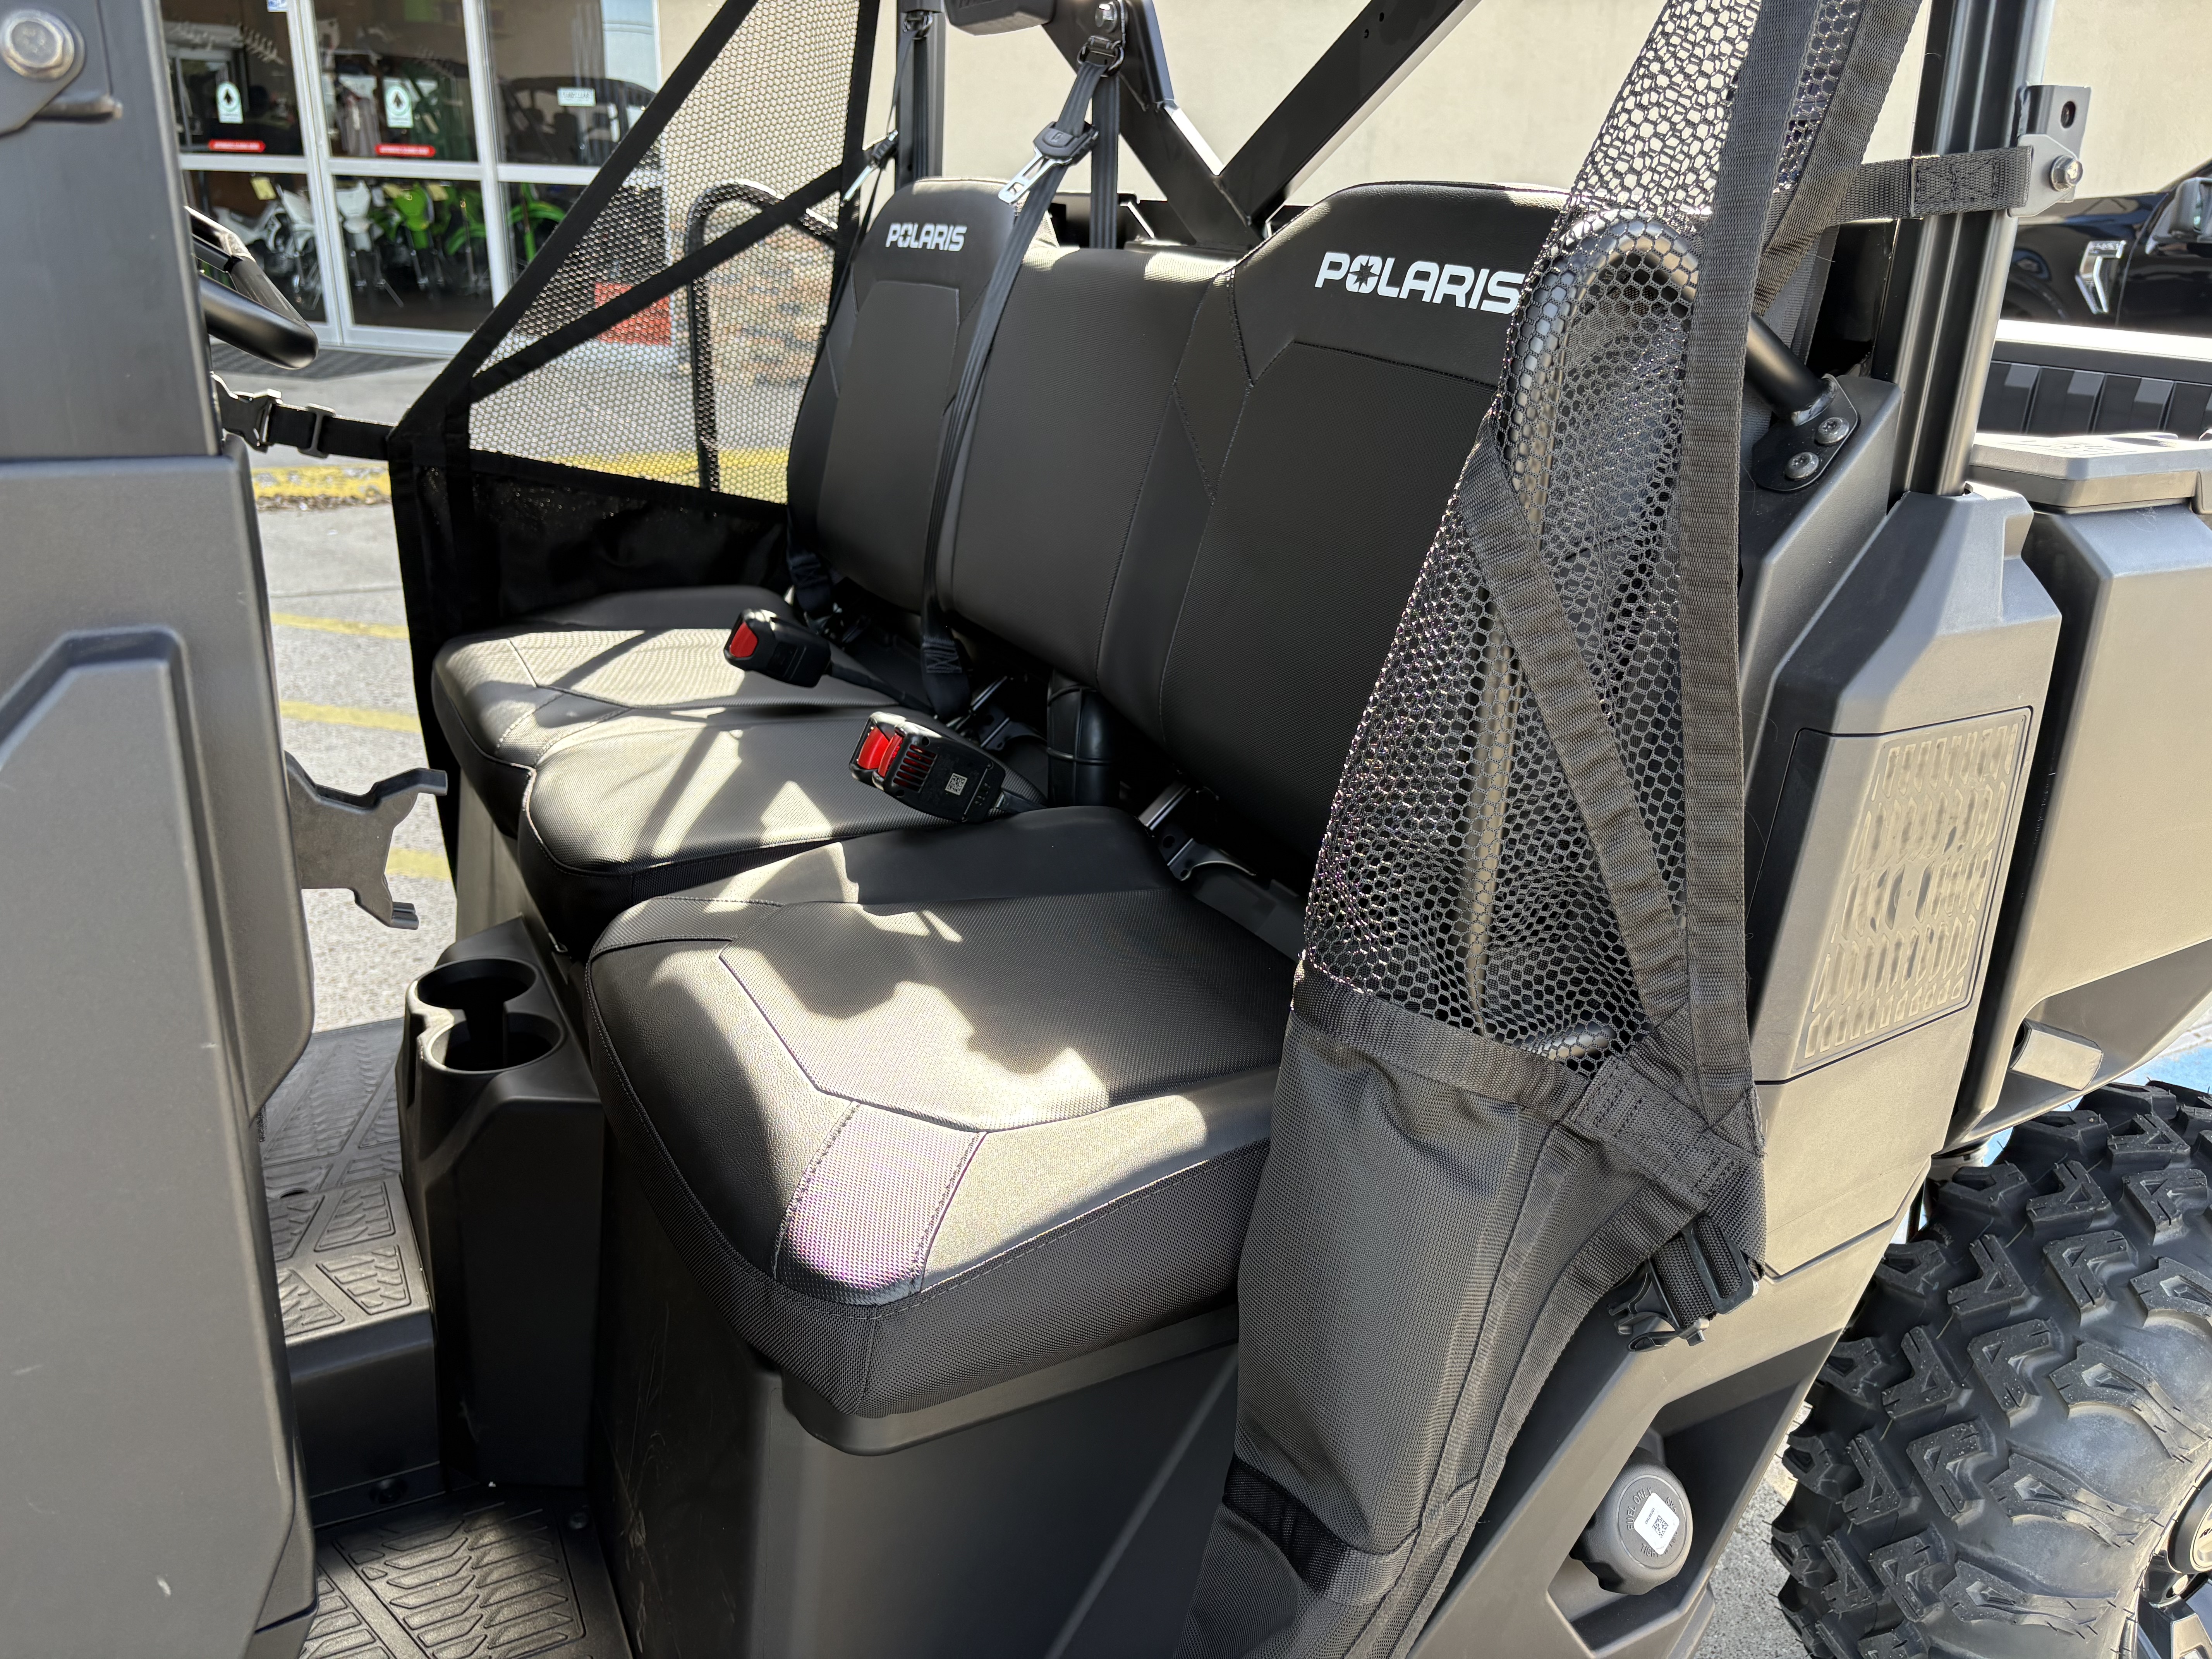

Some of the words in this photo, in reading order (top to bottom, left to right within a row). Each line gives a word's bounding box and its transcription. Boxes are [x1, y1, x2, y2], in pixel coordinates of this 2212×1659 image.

[885, 222, 967, 251] POLARIS
[1315, 251, 1526, 314] POLARIS
[1626, 1506, 1637, 1530] FUEL
[1633, 1487, 1652, 1504] ONLY
